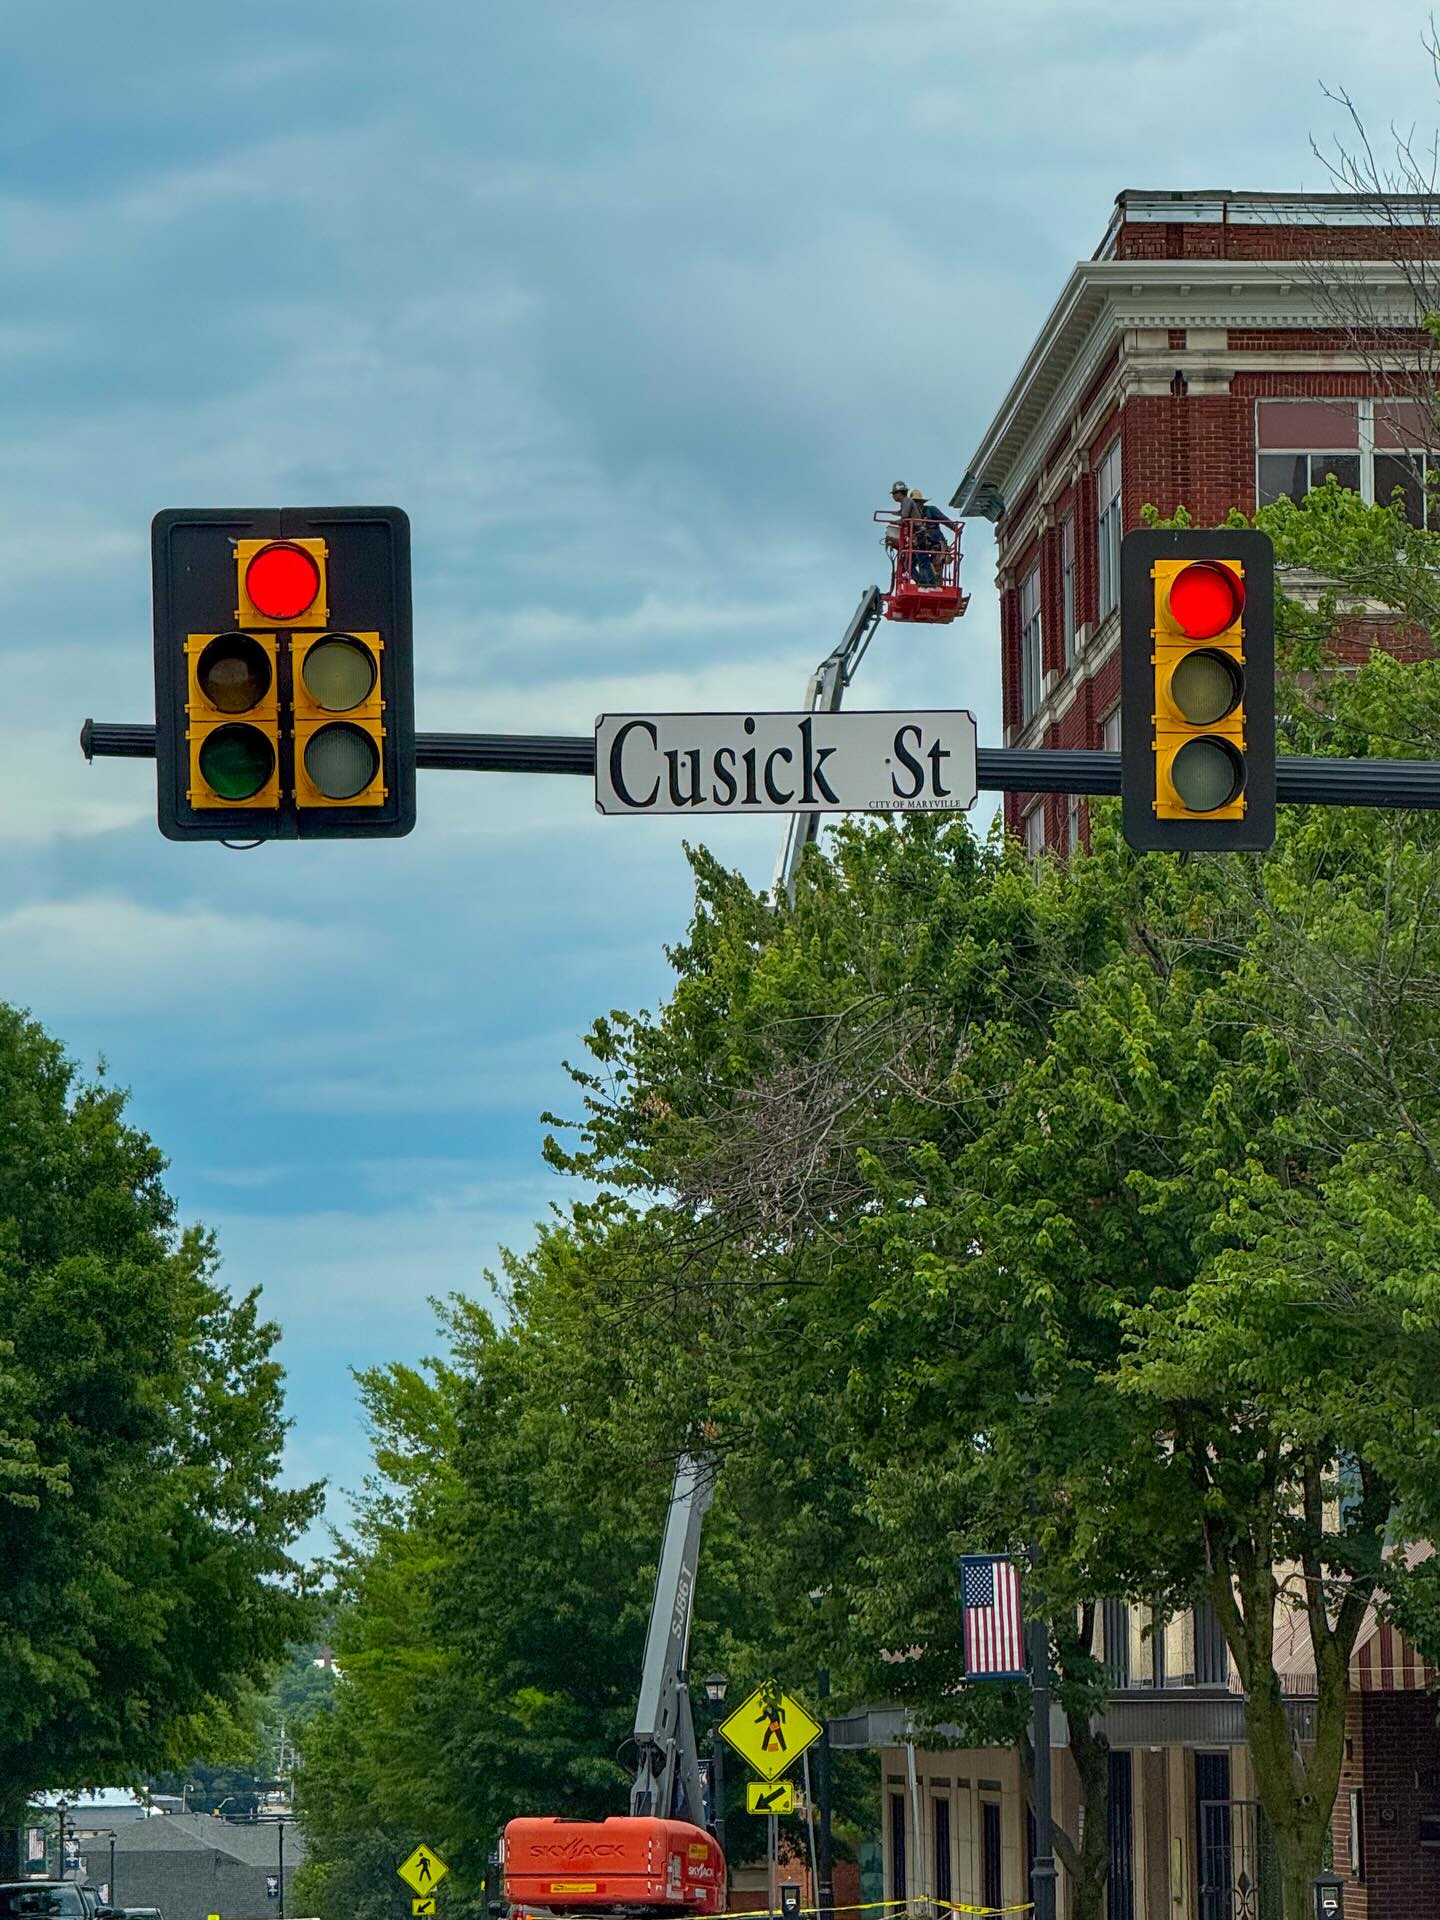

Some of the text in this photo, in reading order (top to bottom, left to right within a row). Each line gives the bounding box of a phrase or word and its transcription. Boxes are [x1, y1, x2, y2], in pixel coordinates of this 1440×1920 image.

[609, 716, 951, 808] Cusick St
[868, 800, 961, 809] CITY OF MARYVILLE
[530, 1837, 625, 1859] SKYJACK
